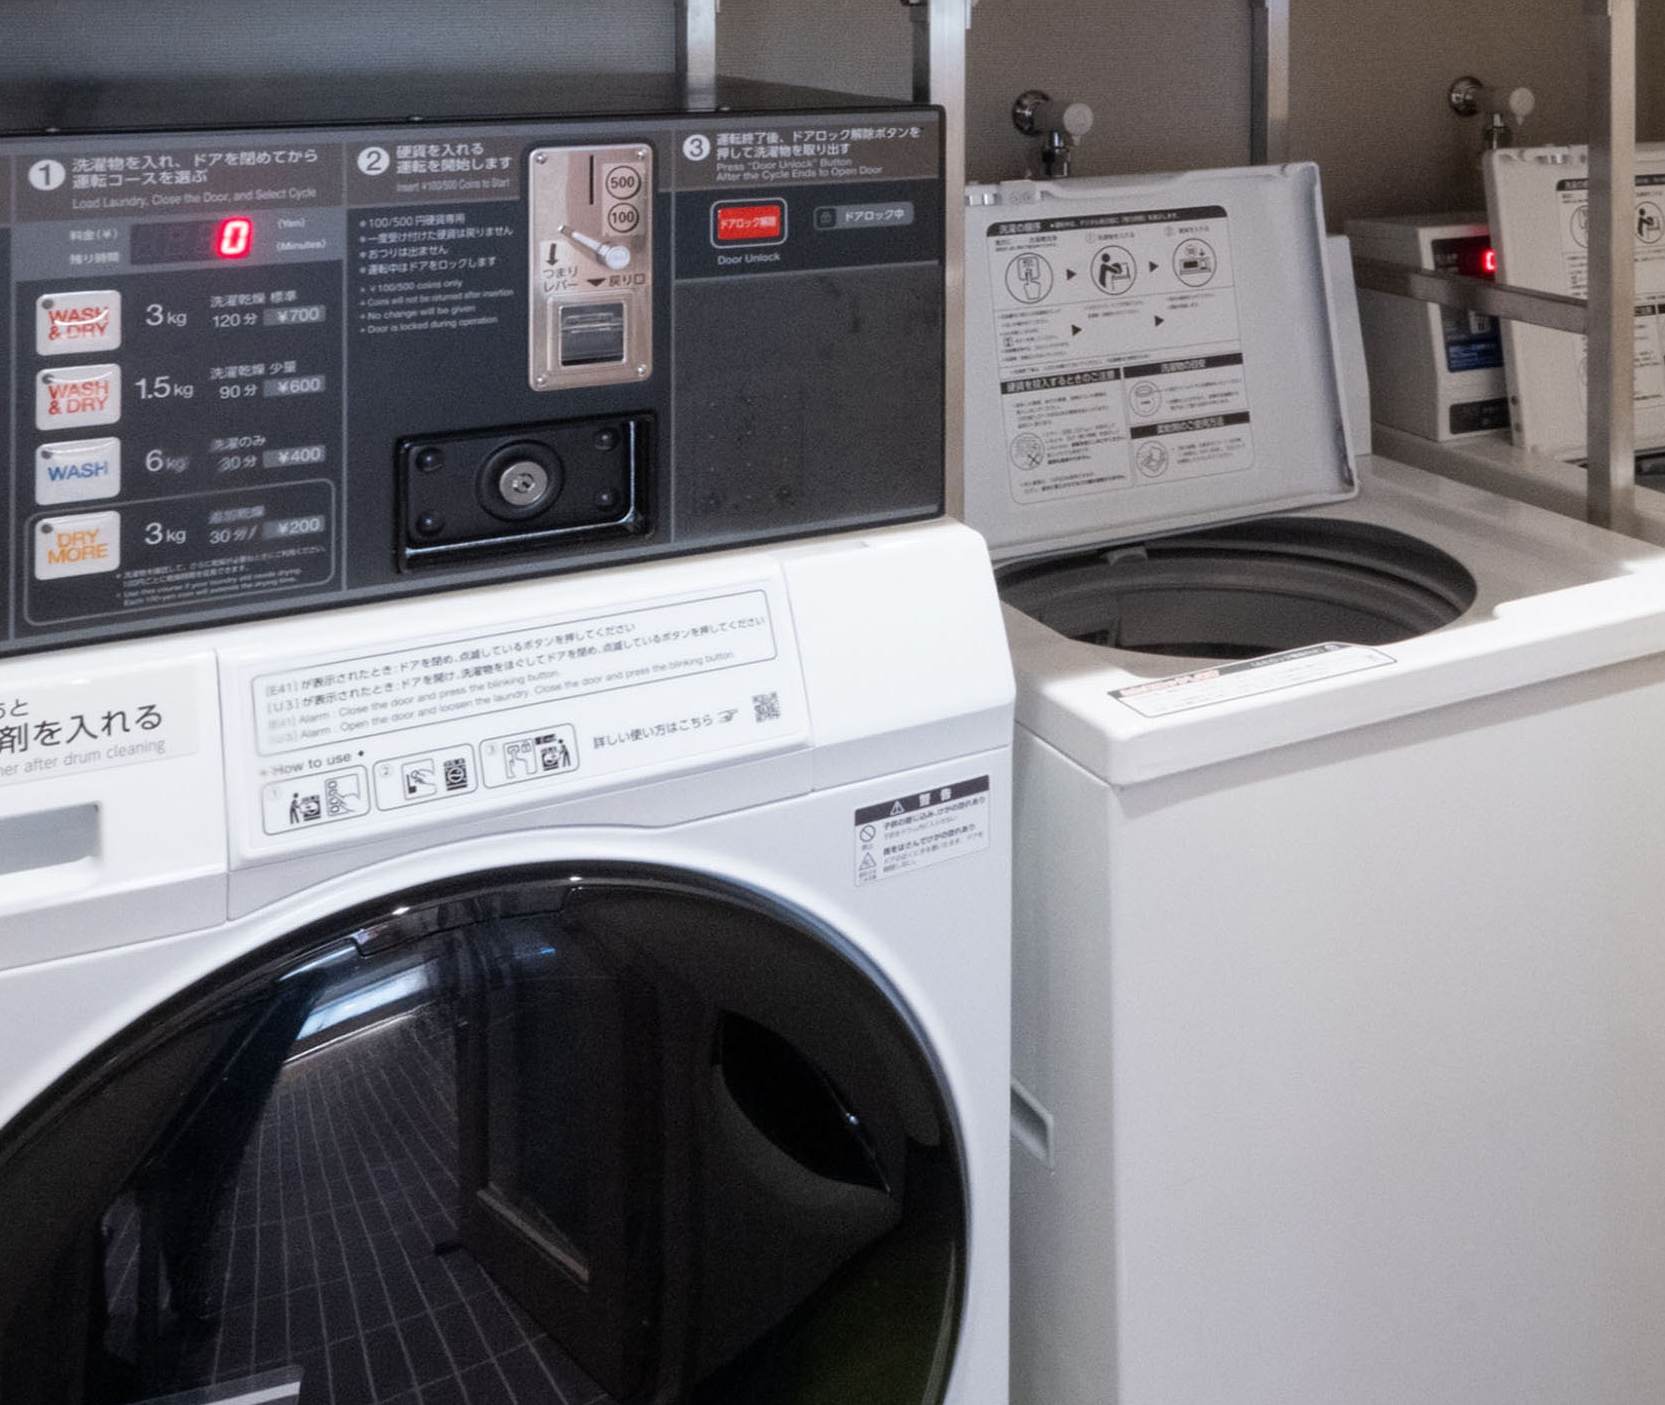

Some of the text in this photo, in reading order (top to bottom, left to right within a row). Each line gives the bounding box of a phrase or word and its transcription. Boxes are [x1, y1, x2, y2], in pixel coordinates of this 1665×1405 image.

[716, 127, 921, 146] 運転終了後、ドアロック解除ボタンを
[72, 148, 318, 172] 洗濯物を入れ、ドアを閉めてから
[396, 143, 485, 160] 硬貨を入れる
[716, 142, 850, 160] 押して洗濯物を取り出す
[396, 157, 512, 175] 運転を開始します
[716, 157, 852, 172] Press Button
[716, 164, 883, 182] After Cycle Ends Open Door
[72, 168, 209, 190] 運転コースを選ぶ
[610, 175, 636, 189] 500
[72, 186, 317, 209] Load Close Select Cycle
[610, 211, 635, 224] 100
[720, 215, 777, 230] ドアロック解除
[845, 208, 905, 223] ドアロック中
[218, 217, 251, 258] 0
[368, 226, 514, 245] 一度受け付けた硬貨は戻りません
[69, 251, 120, 266] 残り時間
[368, 244, 449, 260] おつりは出ません
[717, 252, 781, 265] Door Unlock
[368, 256, 496, 276] 運転中はドアをロックします
[543, 265, 578, 280] つまり
[543, 279, 578, 294] レバー
[608, 272, 646, 287] 戻り口
[210, 289, 299, 308] 洗濯乾燥 標準
[277, 307, 321, 323] ¥700
[48, 323, 108, 341] & DRY
[210, 360, 297, 381] 洗濯乾燥 少量
[48, 380, 109, 399] WASH
[277, 377, 321, 393] ¥600
[48, 396, 109, 416] & DRY
[212, 434, 266, 451] 洗濯のみ
[278, 448, 322, 464] ¥400
[48, 460, 109, 483] WASH
[277, 518, 321, 534] ¥200
[57, 528, 100, 549] DRY
[47, 543, 110, 565] MORE
[338, 676, 525, 717] Close door press blinking
[340, 654, 704, 733] Open door loosen Close door press blinking
[593, 709, 714, 750] 詳しい使い方はこちら
[24, 755, 58, 774] after
[63, 750, 102, 769] drum
[104, 738, 166, 761] cleaning
[272, 751, 352, 776] How use
